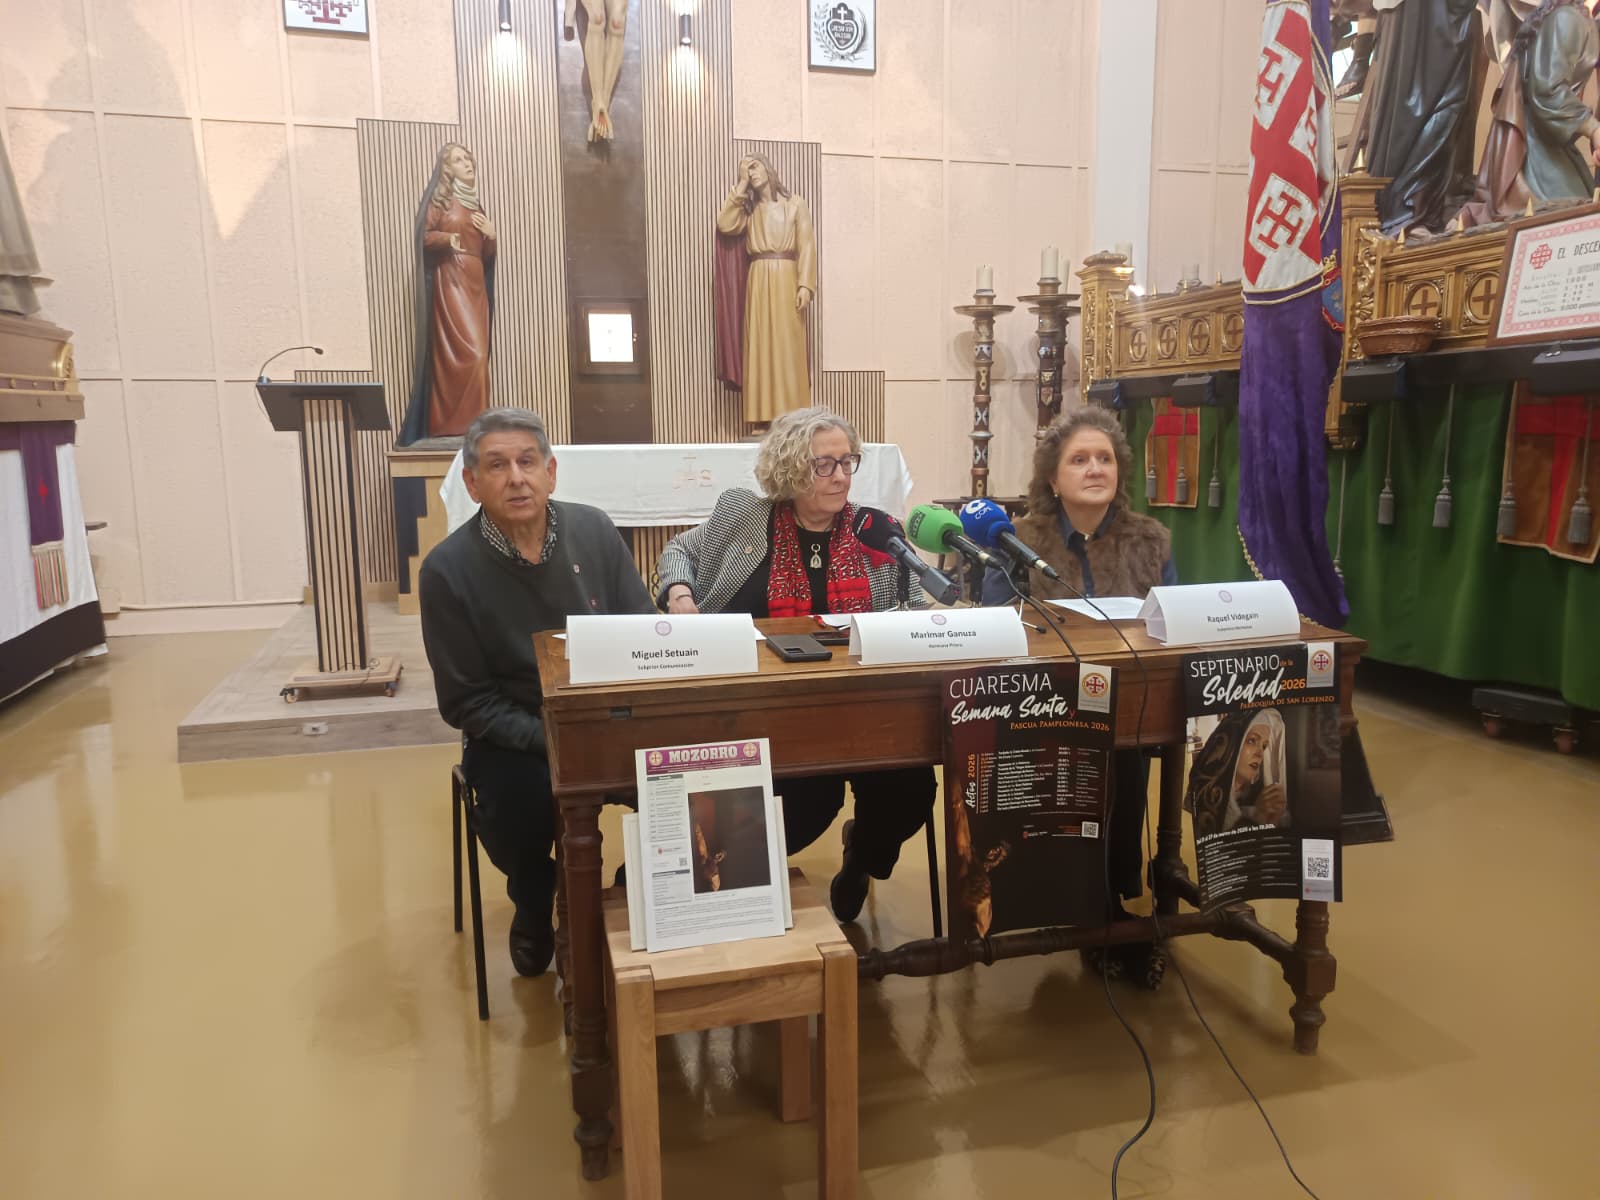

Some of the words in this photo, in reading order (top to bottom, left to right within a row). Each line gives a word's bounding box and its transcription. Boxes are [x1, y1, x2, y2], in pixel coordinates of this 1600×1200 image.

[1207, 614, 1230, 624] Raquel
[910, 631, 945, 639] Marimar
[947, 630, 977, 638] Ganuza
[631, 649, 663, 660] Miguel
[665, 648, 699, 658] Setuain
[1190, 654, 1280, 678] SEPTENARIO
[950, 672, 1052, 699] CUARESMA
[1202, 667, 1285, 706] Soledad
[1281, 678, 1306, 690] 2026
[951, 700, 1012, 725] Semana
[1019, 693, 1069, 719] Santa
[1286, 697, 1300, 705] SAN
[1301, 695, 1335, 704] LORENZO
[1010, 720, 1038, 730] PASCUA
[1039, 719, 1089, 729] PAMPLONESA
[1090, 721, 1110, 732] 2026
[668, 745, 738, 764] MOZORRO
[967, 754, 976, 778] 2026
